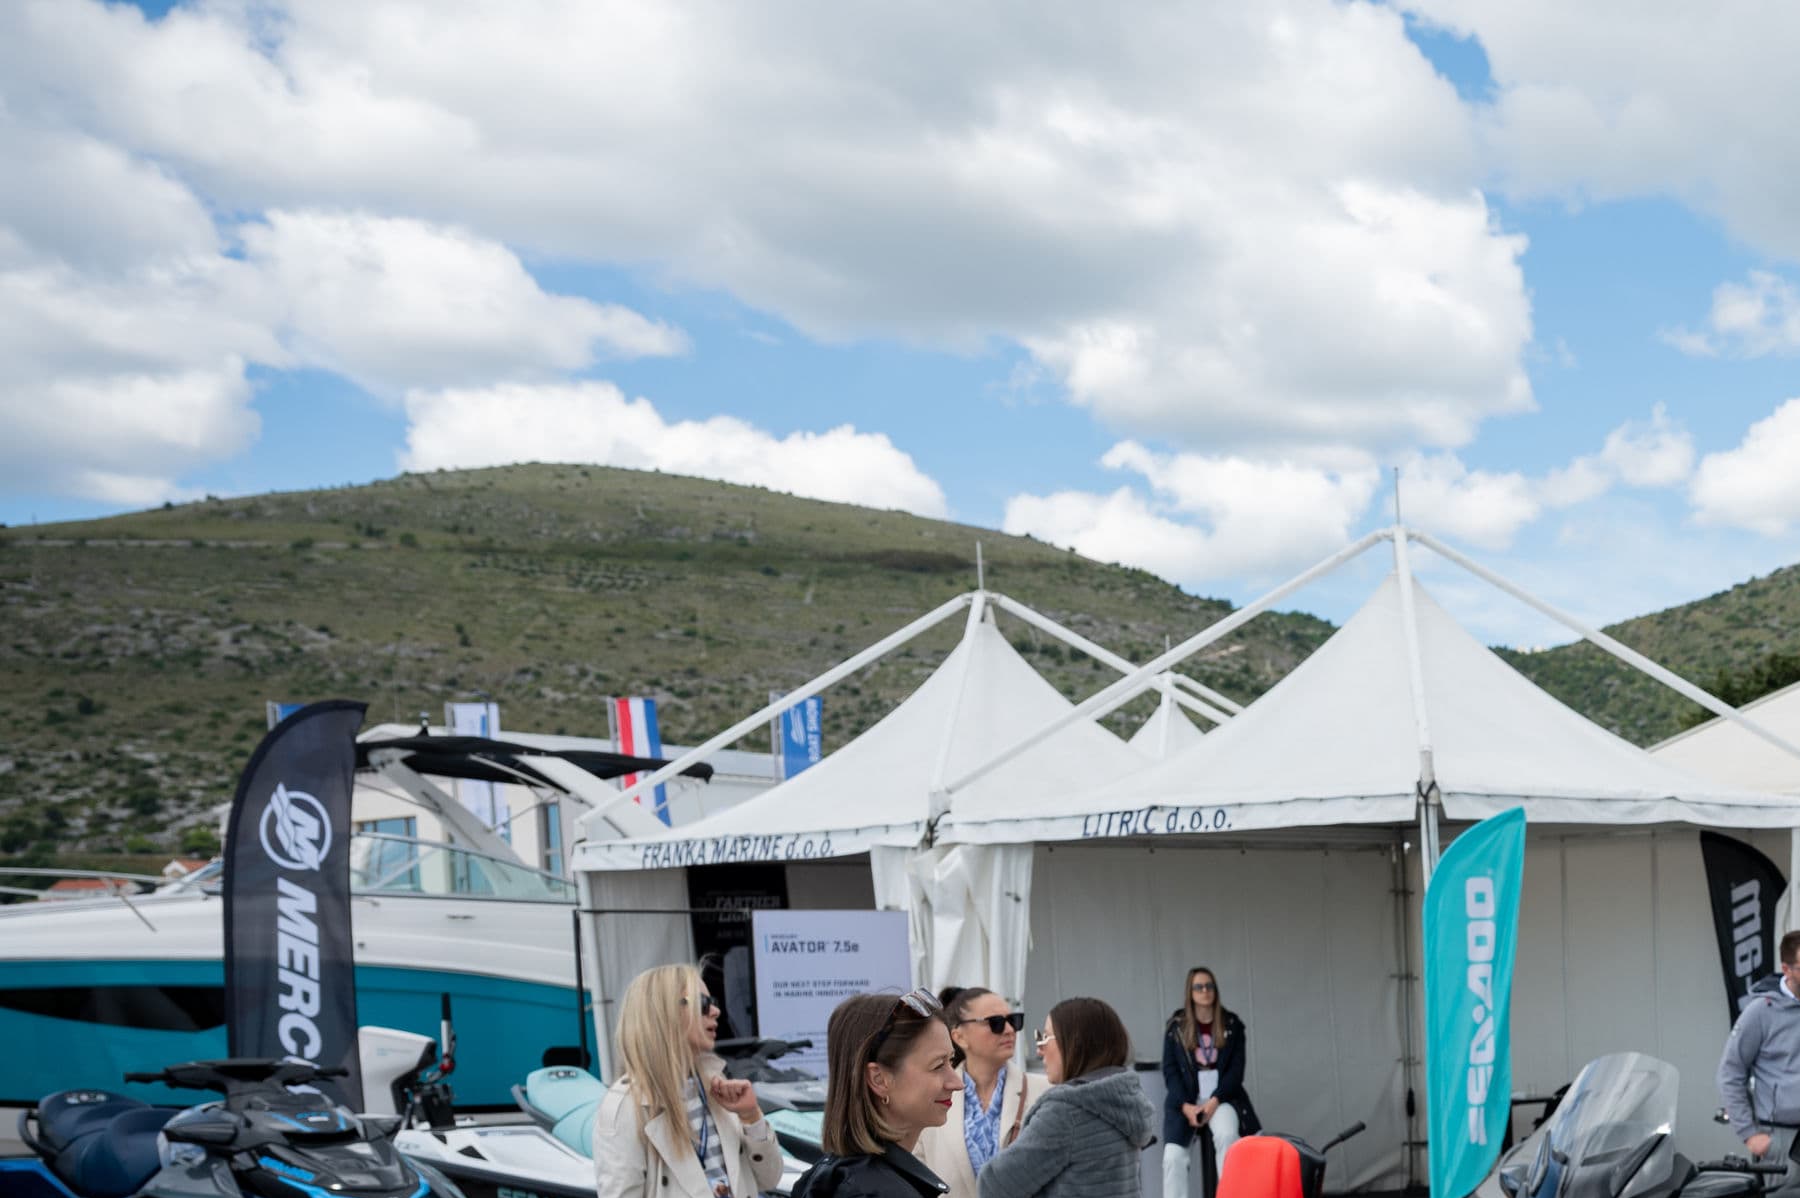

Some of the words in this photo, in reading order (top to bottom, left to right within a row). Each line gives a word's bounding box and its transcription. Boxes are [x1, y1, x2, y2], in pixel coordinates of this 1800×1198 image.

[642, 841, 707, 869] FRANKA
[711, 835, 783, 864] MARINE
[833, 941, 860, 954] 7.5e
